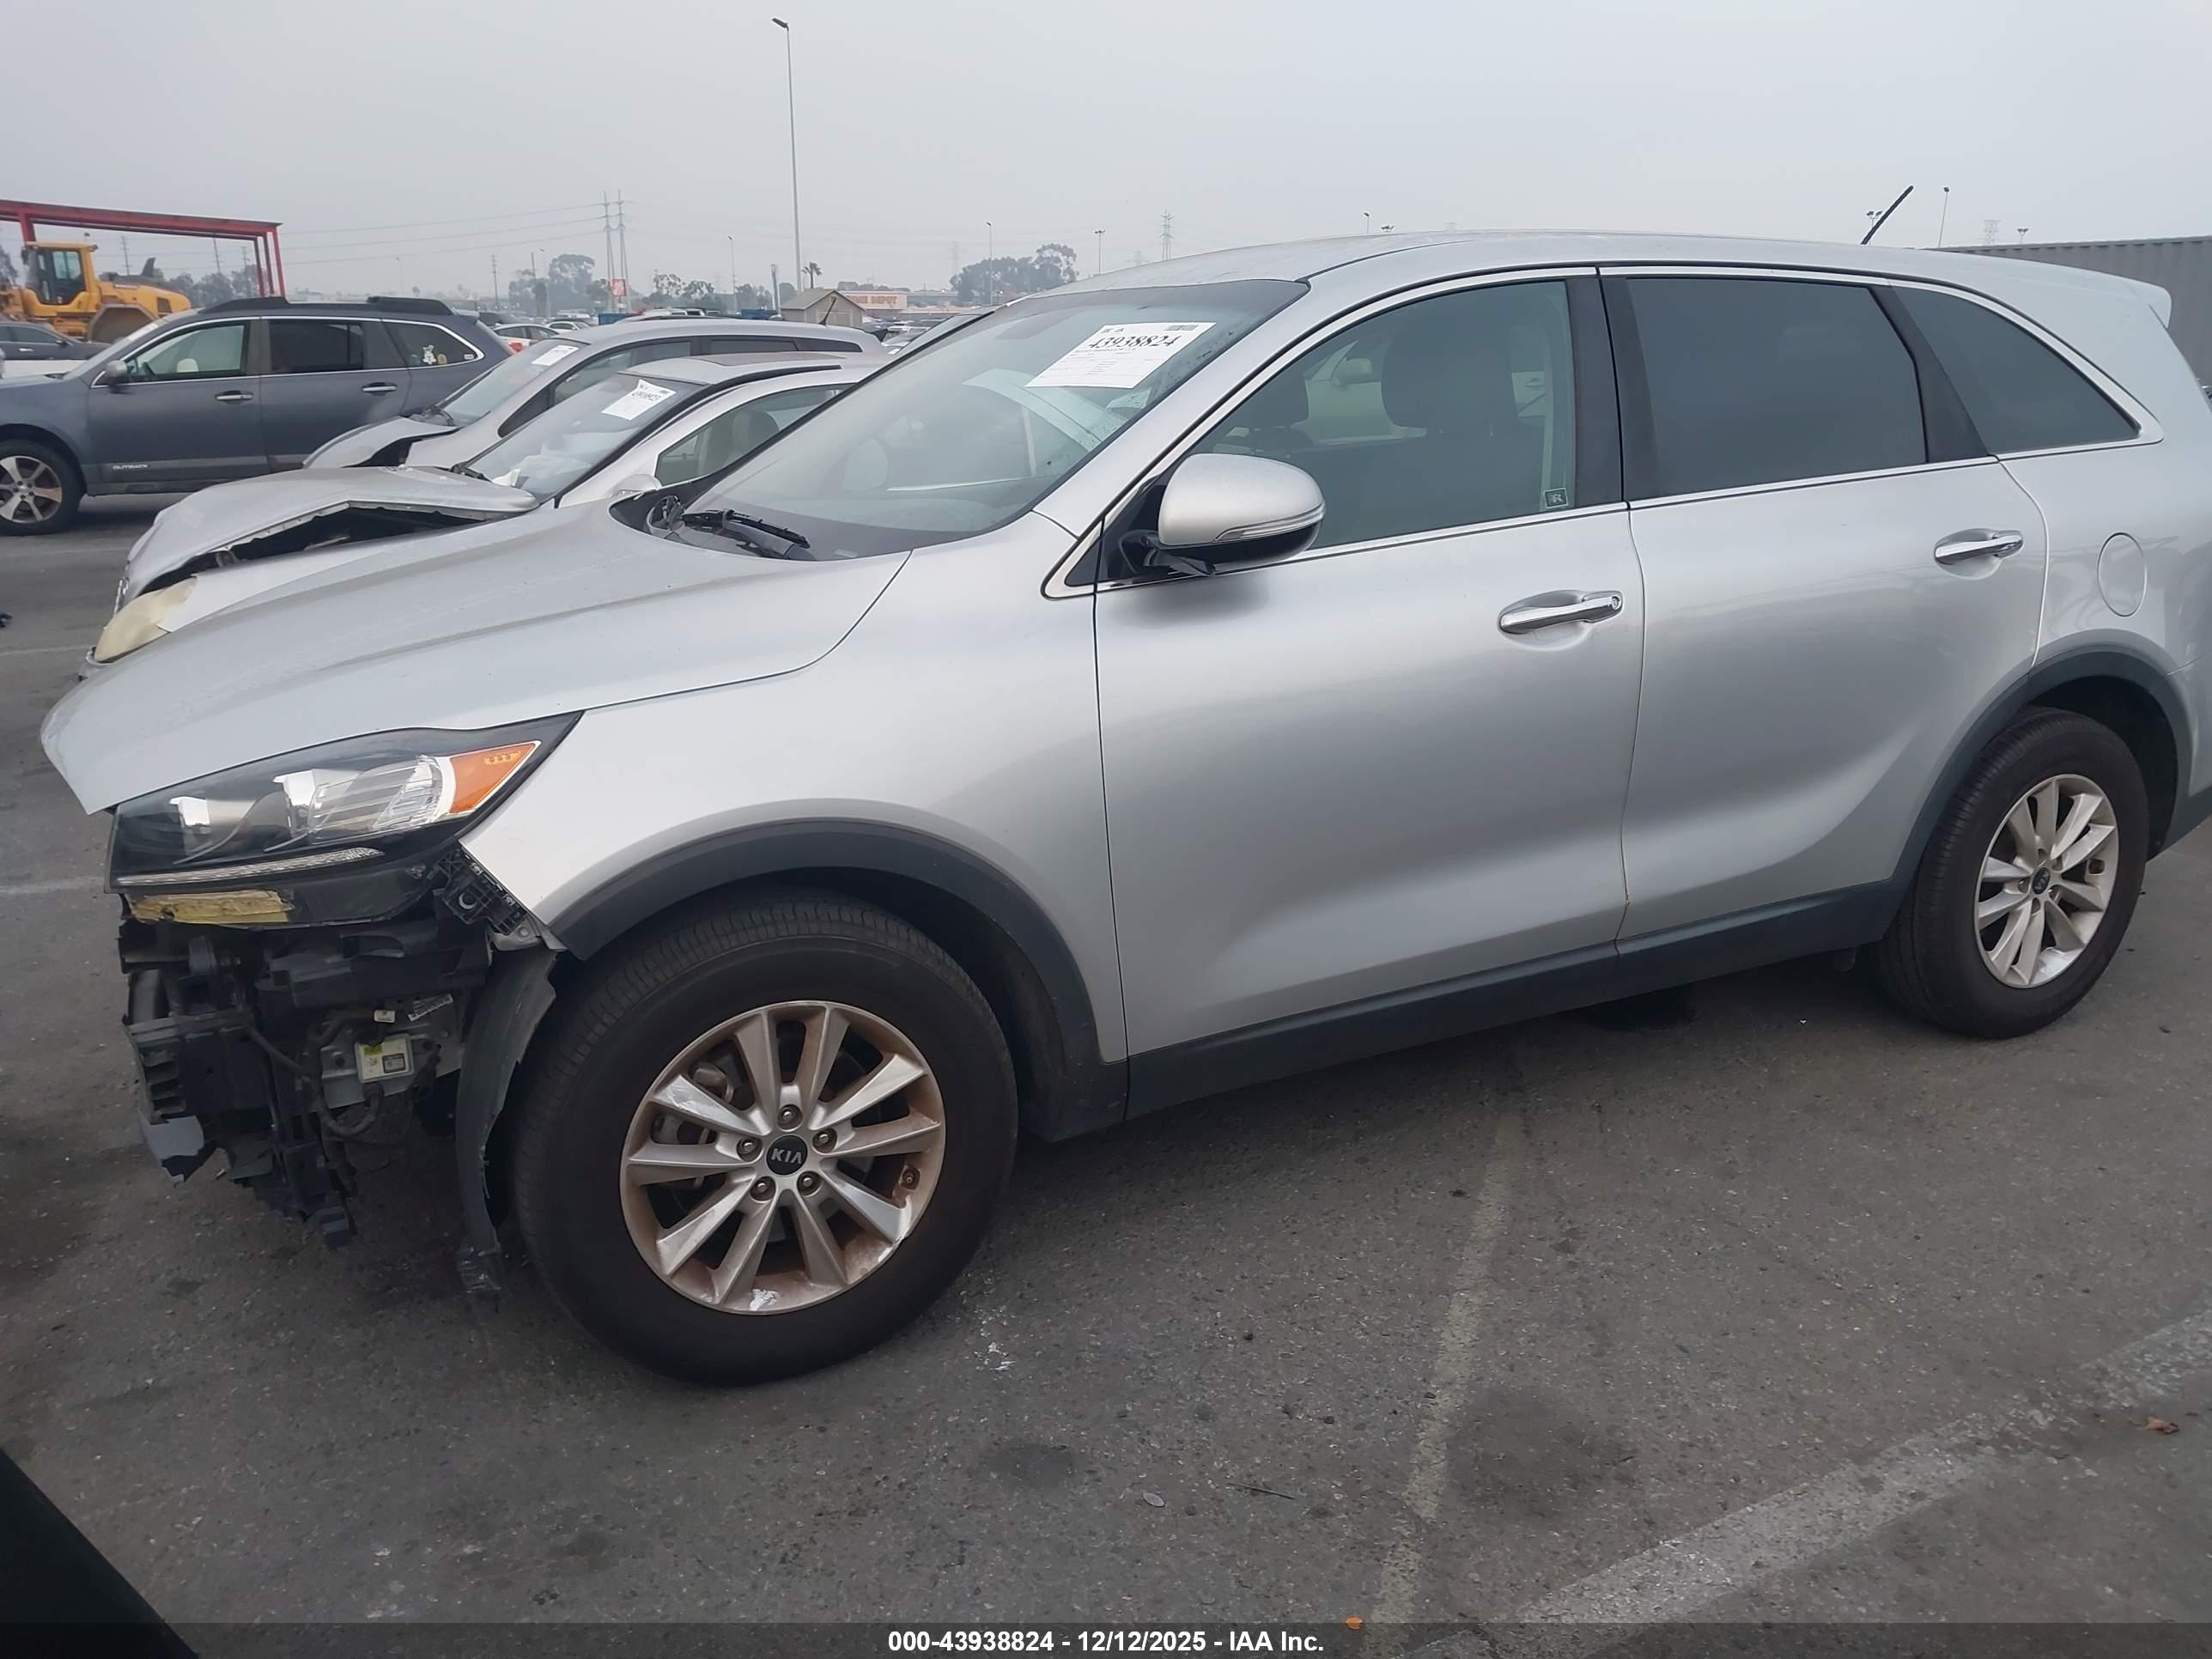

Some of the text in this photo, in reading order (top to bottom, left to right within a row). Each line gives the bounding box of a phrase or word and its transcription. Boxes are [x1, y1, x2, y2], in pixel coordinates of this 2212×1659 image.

[851, 295, 868, 304] OME
[1089, 335, 1182, 348] 43938824
[770, 1147, 802, 1164] KIA
